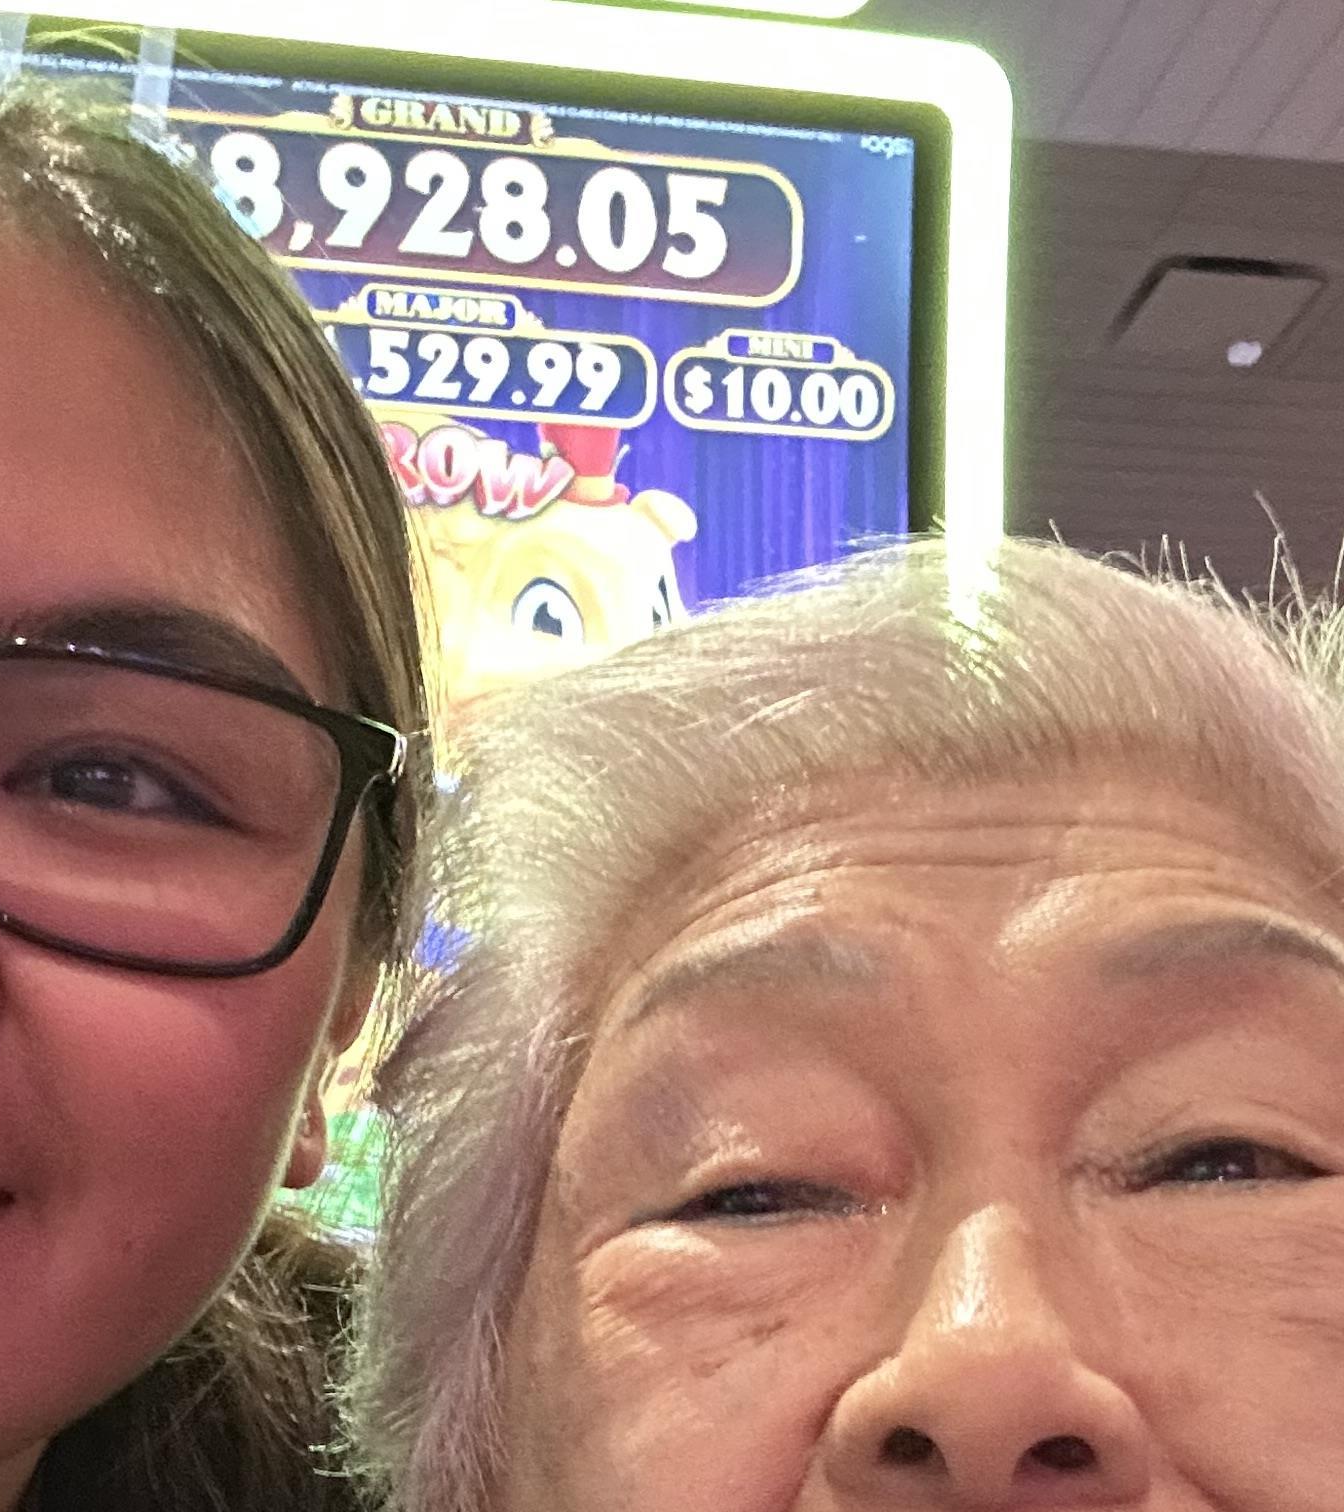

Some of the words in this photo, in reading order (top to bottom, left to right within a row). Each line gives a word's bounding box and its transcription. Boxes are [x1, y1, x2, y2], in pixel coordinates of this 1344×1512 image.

[359, 97, 522, 138] GRAND
[375, 289, 508, 325] MAJOR
[683, 365, 880, 428] $10.00
